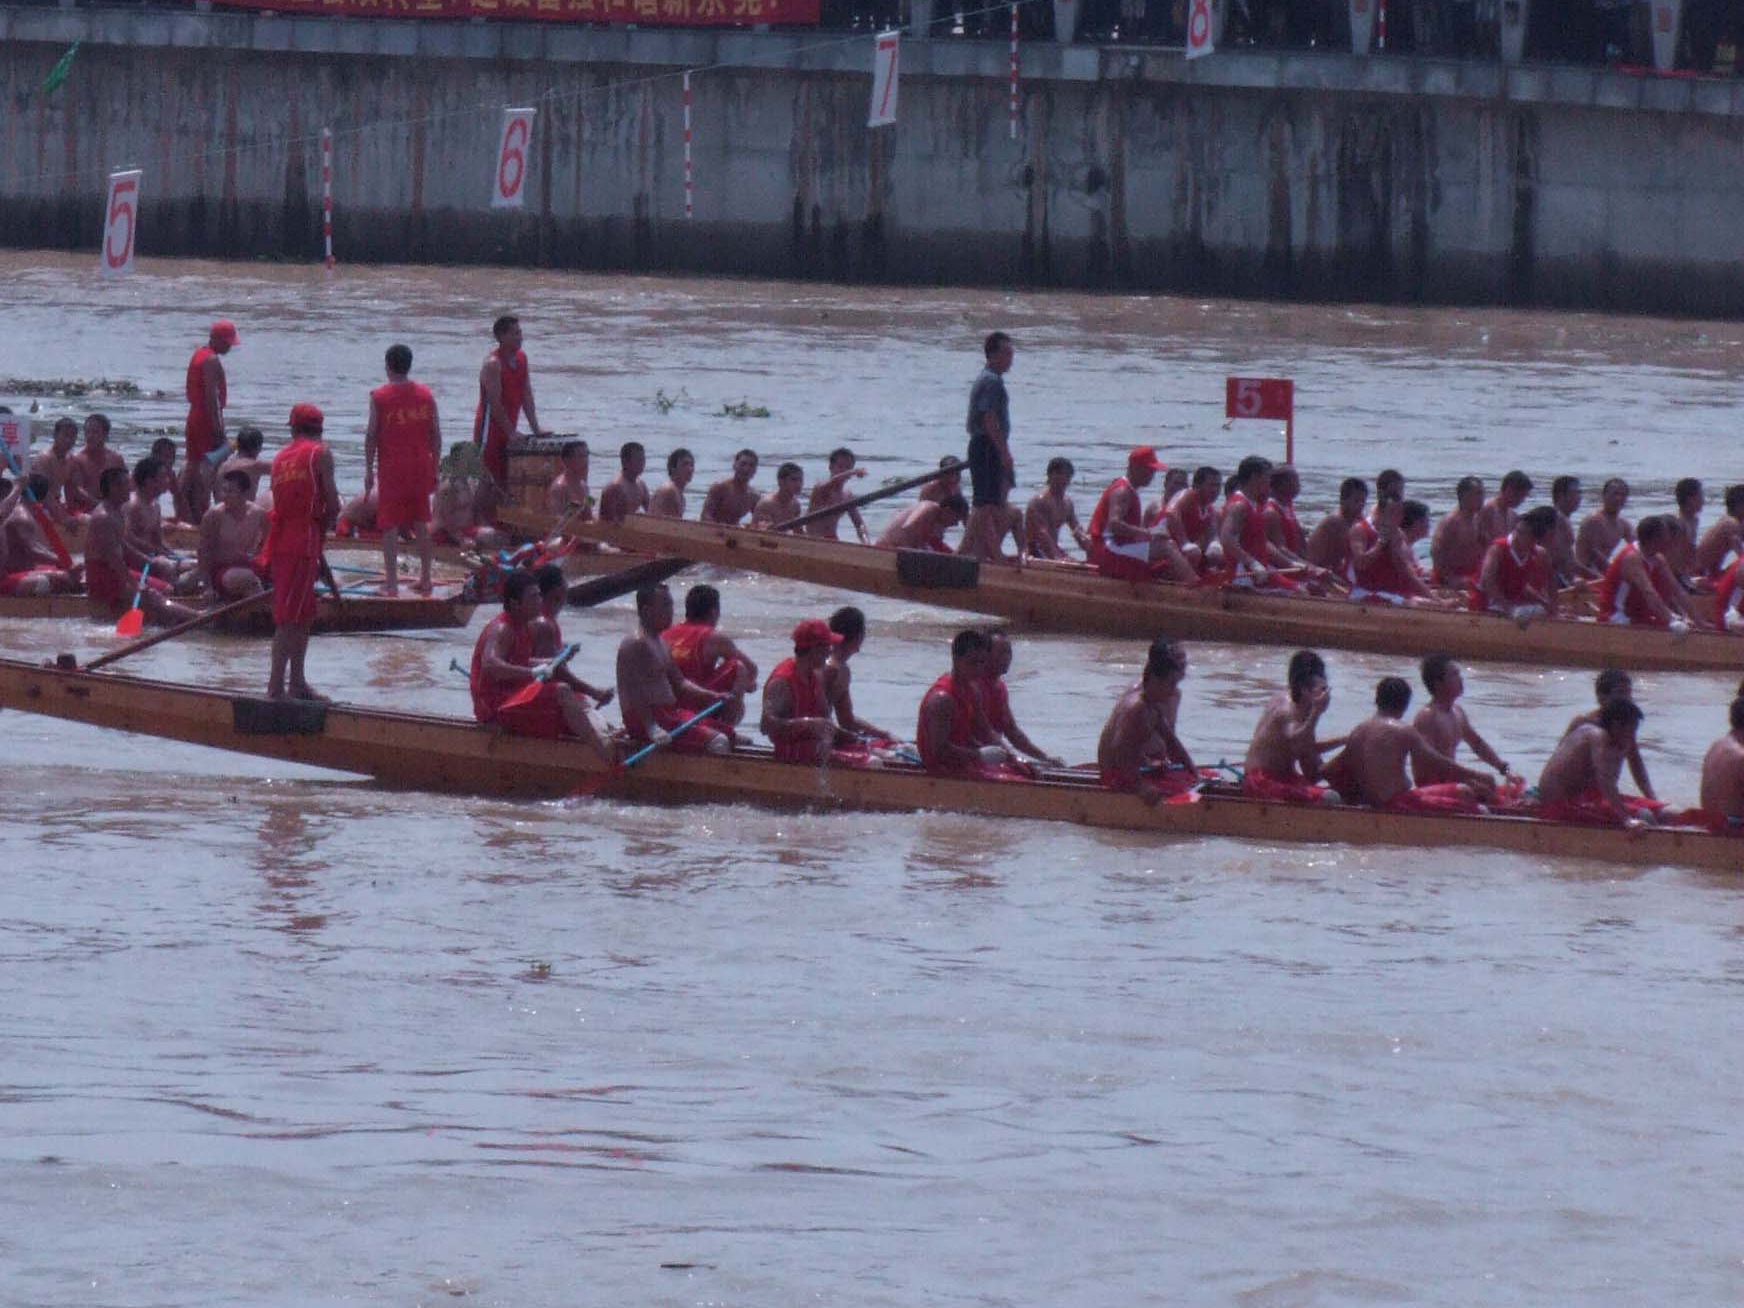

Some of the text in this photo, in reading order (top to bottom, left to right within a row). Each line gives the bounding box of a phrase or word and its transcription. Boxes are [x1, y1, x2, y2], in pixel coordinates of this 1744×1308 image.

[878, 41, 897, 117] 7
[498, 118, 528, 199] 6
[107, 179, 137, 270] 5
[1236, 378, 1264, 417] 5
